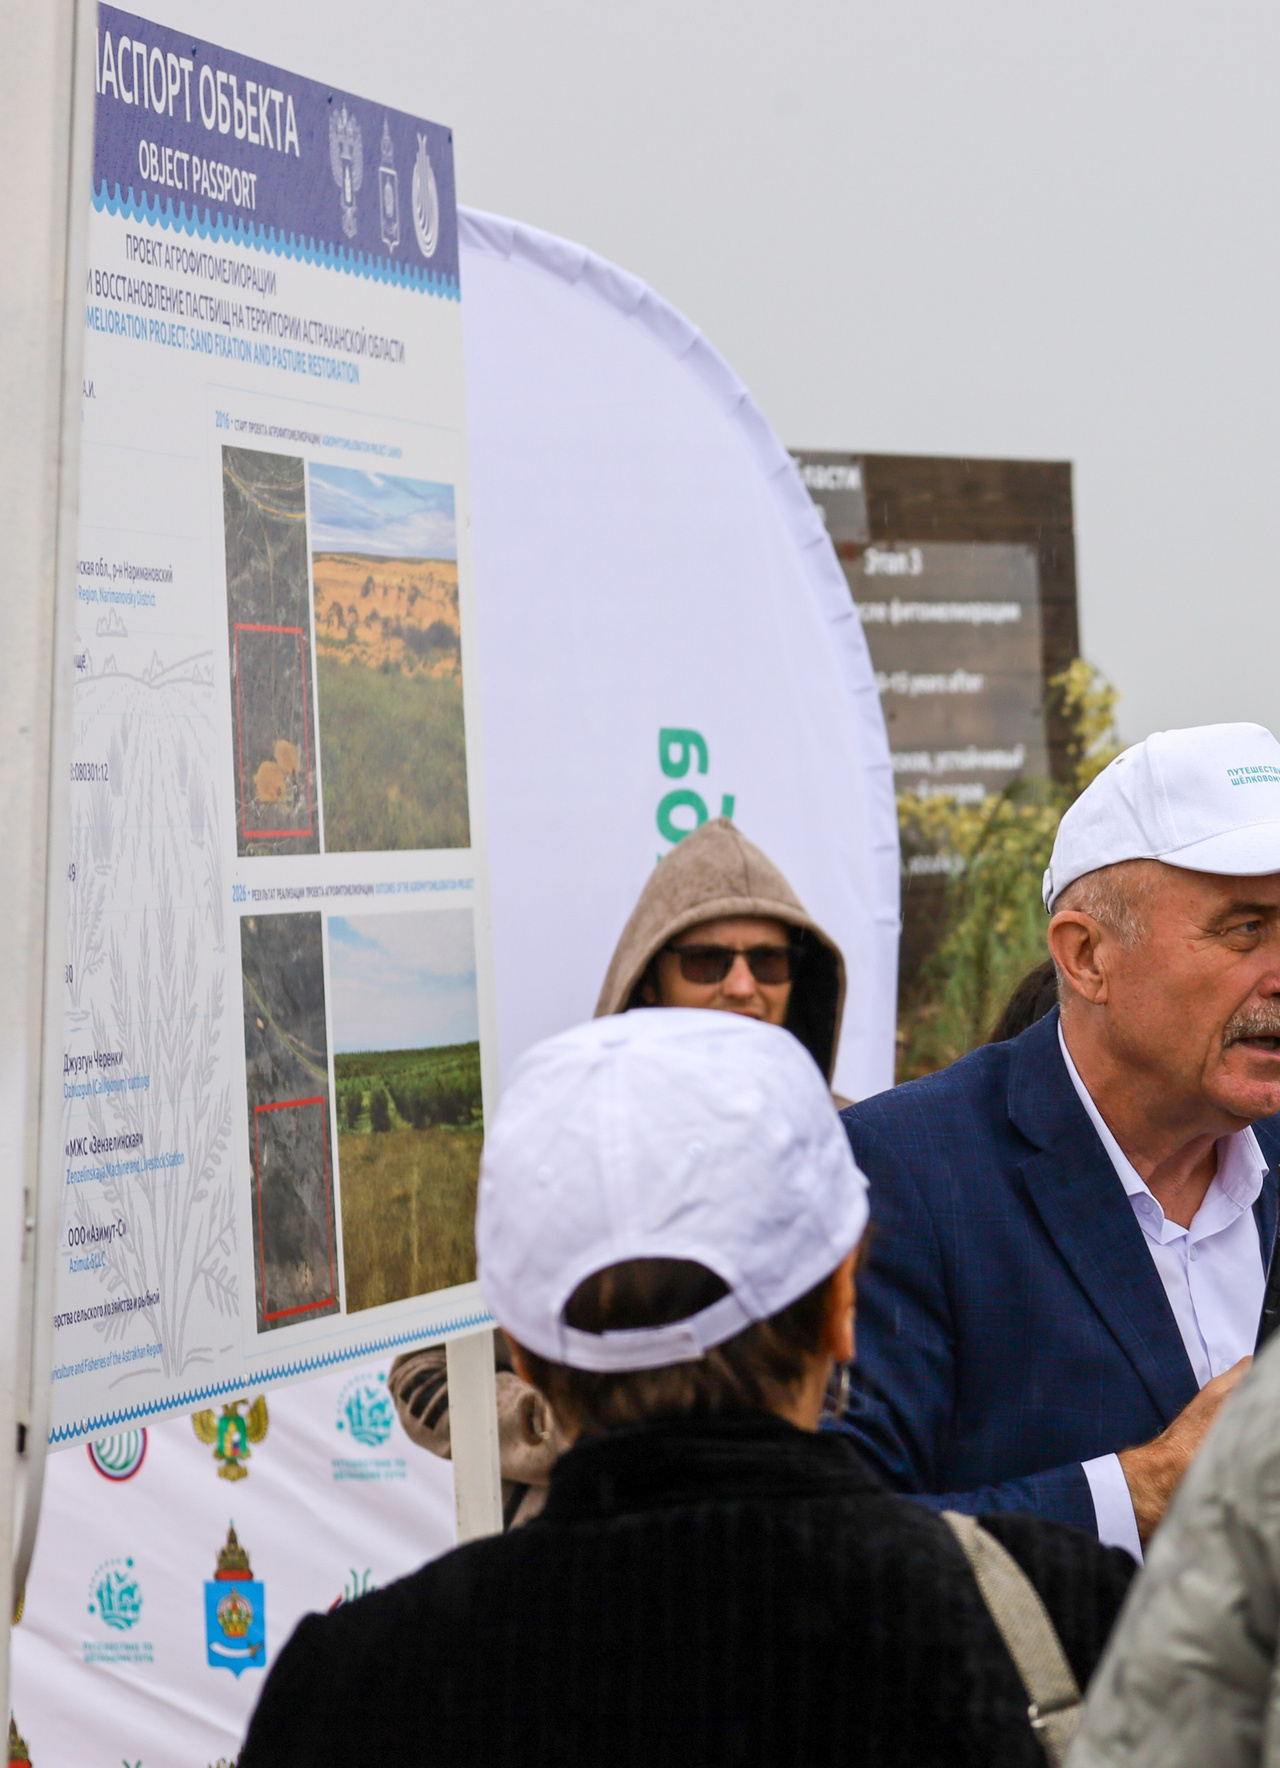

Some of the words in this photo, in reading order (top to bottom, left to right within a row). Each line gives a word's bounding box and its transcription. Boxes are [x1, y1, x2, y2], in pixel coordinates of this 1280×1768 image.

[95, 28, 194, 122] АСПОРТ
[200, 64, 300, 157] ОБЪЕКТА
[139, 139, 192, 190] OBJECT
[193, 154, 257, 210] PASSPORT
[126, 234, 163, 267] ПРОЕКТ
[164, 246, 277, 298] АГРОФИТОМЕЛИОРАЦИИ
[95, 269, 184, 315] ВОССТАНОВЛЕНИЕ
[186, 291, 231, 332] ПАСТБИЩ
[232, 302, 244, 329] НА
[246, 305, 301, 341] ТЕРРИТОРИИ
[302, 319, 367, 356] АСТРАХАНСКОЙ
[368, 334, 406, 364] ОБЛАСТИ
[85, 305, 147, 341] MELIORATION
[149, 318, 189, 349] PROJECT:
[190, 328, 213, 355] SAND
[214, 333, 252, 363] FIXATION
[253, 343, 271, 367] AND
[272, 346, 306, 374] PASTURE
[307, 353, 360, 385] RESTORATION
[215, 410, 230, 429] 2016
[795, 456, 861, 490] ласти
[112, 563, 123, 582] р-н
[123, 561, 173, 584] Наримановский
[78, 585, 98, 605] Region,
[99, 587, 136, 608] Narimanovsky
[137, 589, 156, 607] District
[232, 884, 247, 902] 2026
[63, 1053, 93, 1076] Джузгун
[93, 1050, 124, 1071] Черенки
[66, 1164, 105, 1185] Zenzelinskaya
[106, 1159, 129, 1178] Machine
[130, 1156, 141, 1174] and
[141, 1152, 165, 1172] Livestock
[165, 1149, 185, 1168] Station
[68, 1225, 86, 1247] ООО
[74, 1305, 103, 1323] сельского
[103, 1297, 133, 1317] хозяйства
[138, 1288, 160, 1312] рыбной
[74, 1358, 84, 1375] and
[84, 1354, 107, 1373] Fisheries
[107, 1351, 113, 1367] of
[112, 1350, 121, 1366] the
[121, 1344, 146, 1363] Astrakhan
[146, 1342, 163, 1359] Region
